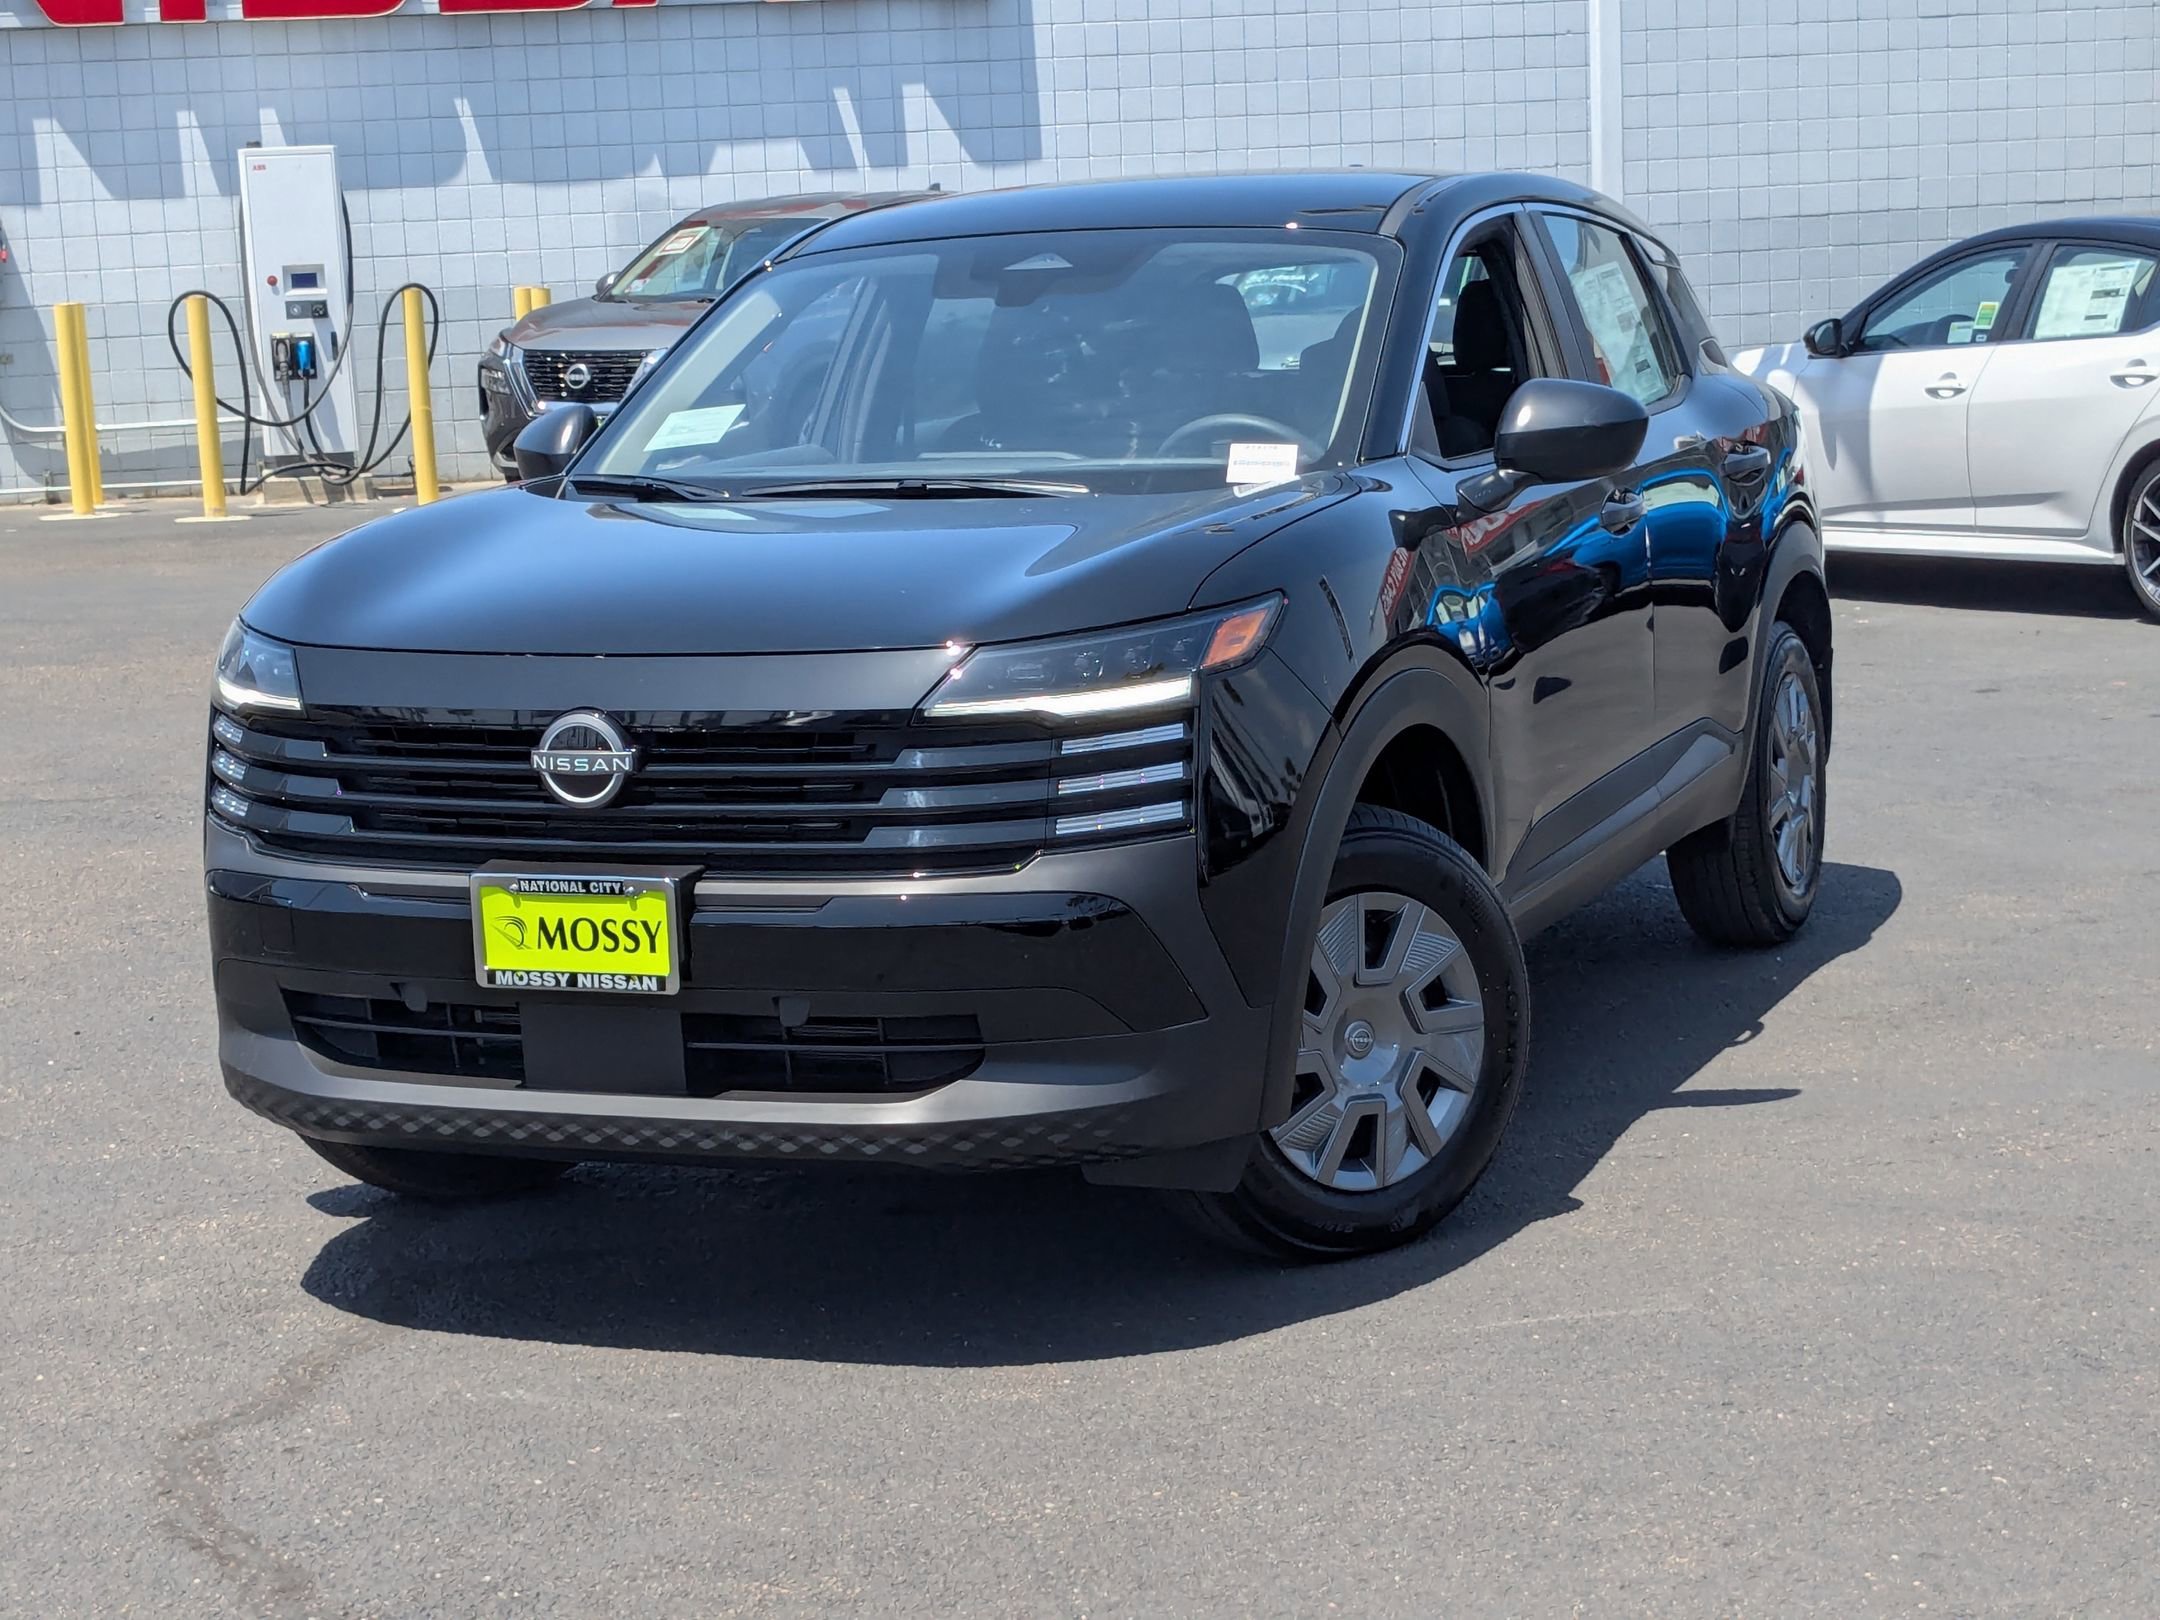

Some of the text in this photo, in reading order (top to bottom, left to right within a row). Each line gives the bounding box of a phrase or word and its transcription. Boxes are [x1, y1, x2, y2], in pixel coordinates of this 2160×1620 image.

[533, 754, 630, 771] NISSAN
[519, 880, 621, 893] NATIONAL CITY
[537, 916, 662, 954] MOSSY
[495, 970, 658, 992] MOSSY NISSAN
